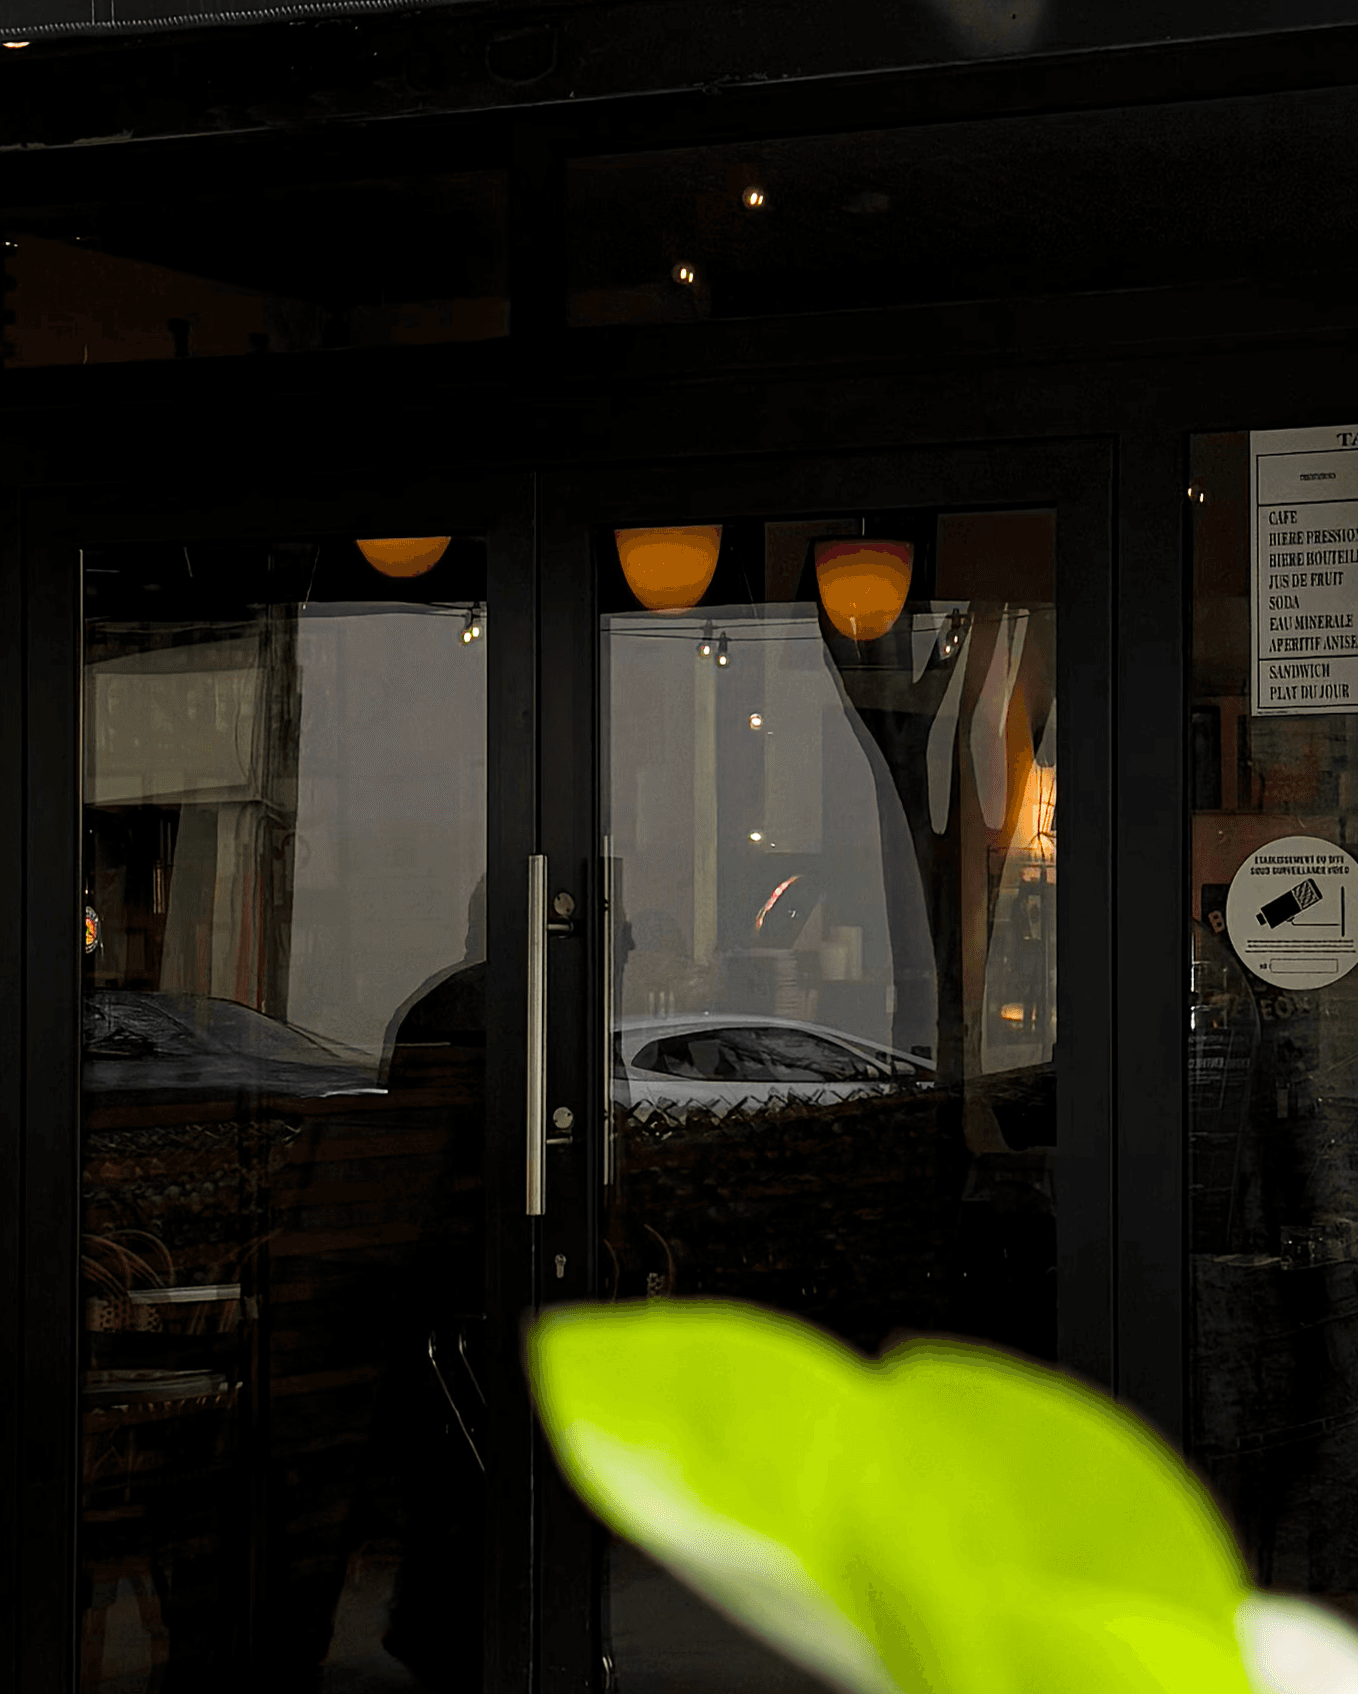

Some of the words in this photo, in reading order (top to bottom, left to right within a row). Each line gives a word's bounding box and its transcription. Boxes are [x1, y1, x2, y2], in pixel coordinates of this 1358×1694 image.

[1268, 510, 1298, 525] CAFE
[1268, 574, 1290, 590] JUS
[1292, 573, 1308, 588] DE
[1310, 571, 1344, 587] FRUIT
[1268, 595, 1300, 610] SODA
[1269, 616, 1292, 631] EAU
[1294, 613, 1354, 630] MINERALE
[1268, 636, 1322, 653] APERITIF
[1268, 662, 1331, 680] SANDWICH
[1269, 686, 1299, 701] PLAT
[1300, 684, 1318, 700] DU
[1319, 683, 1350, 699] JOUR
